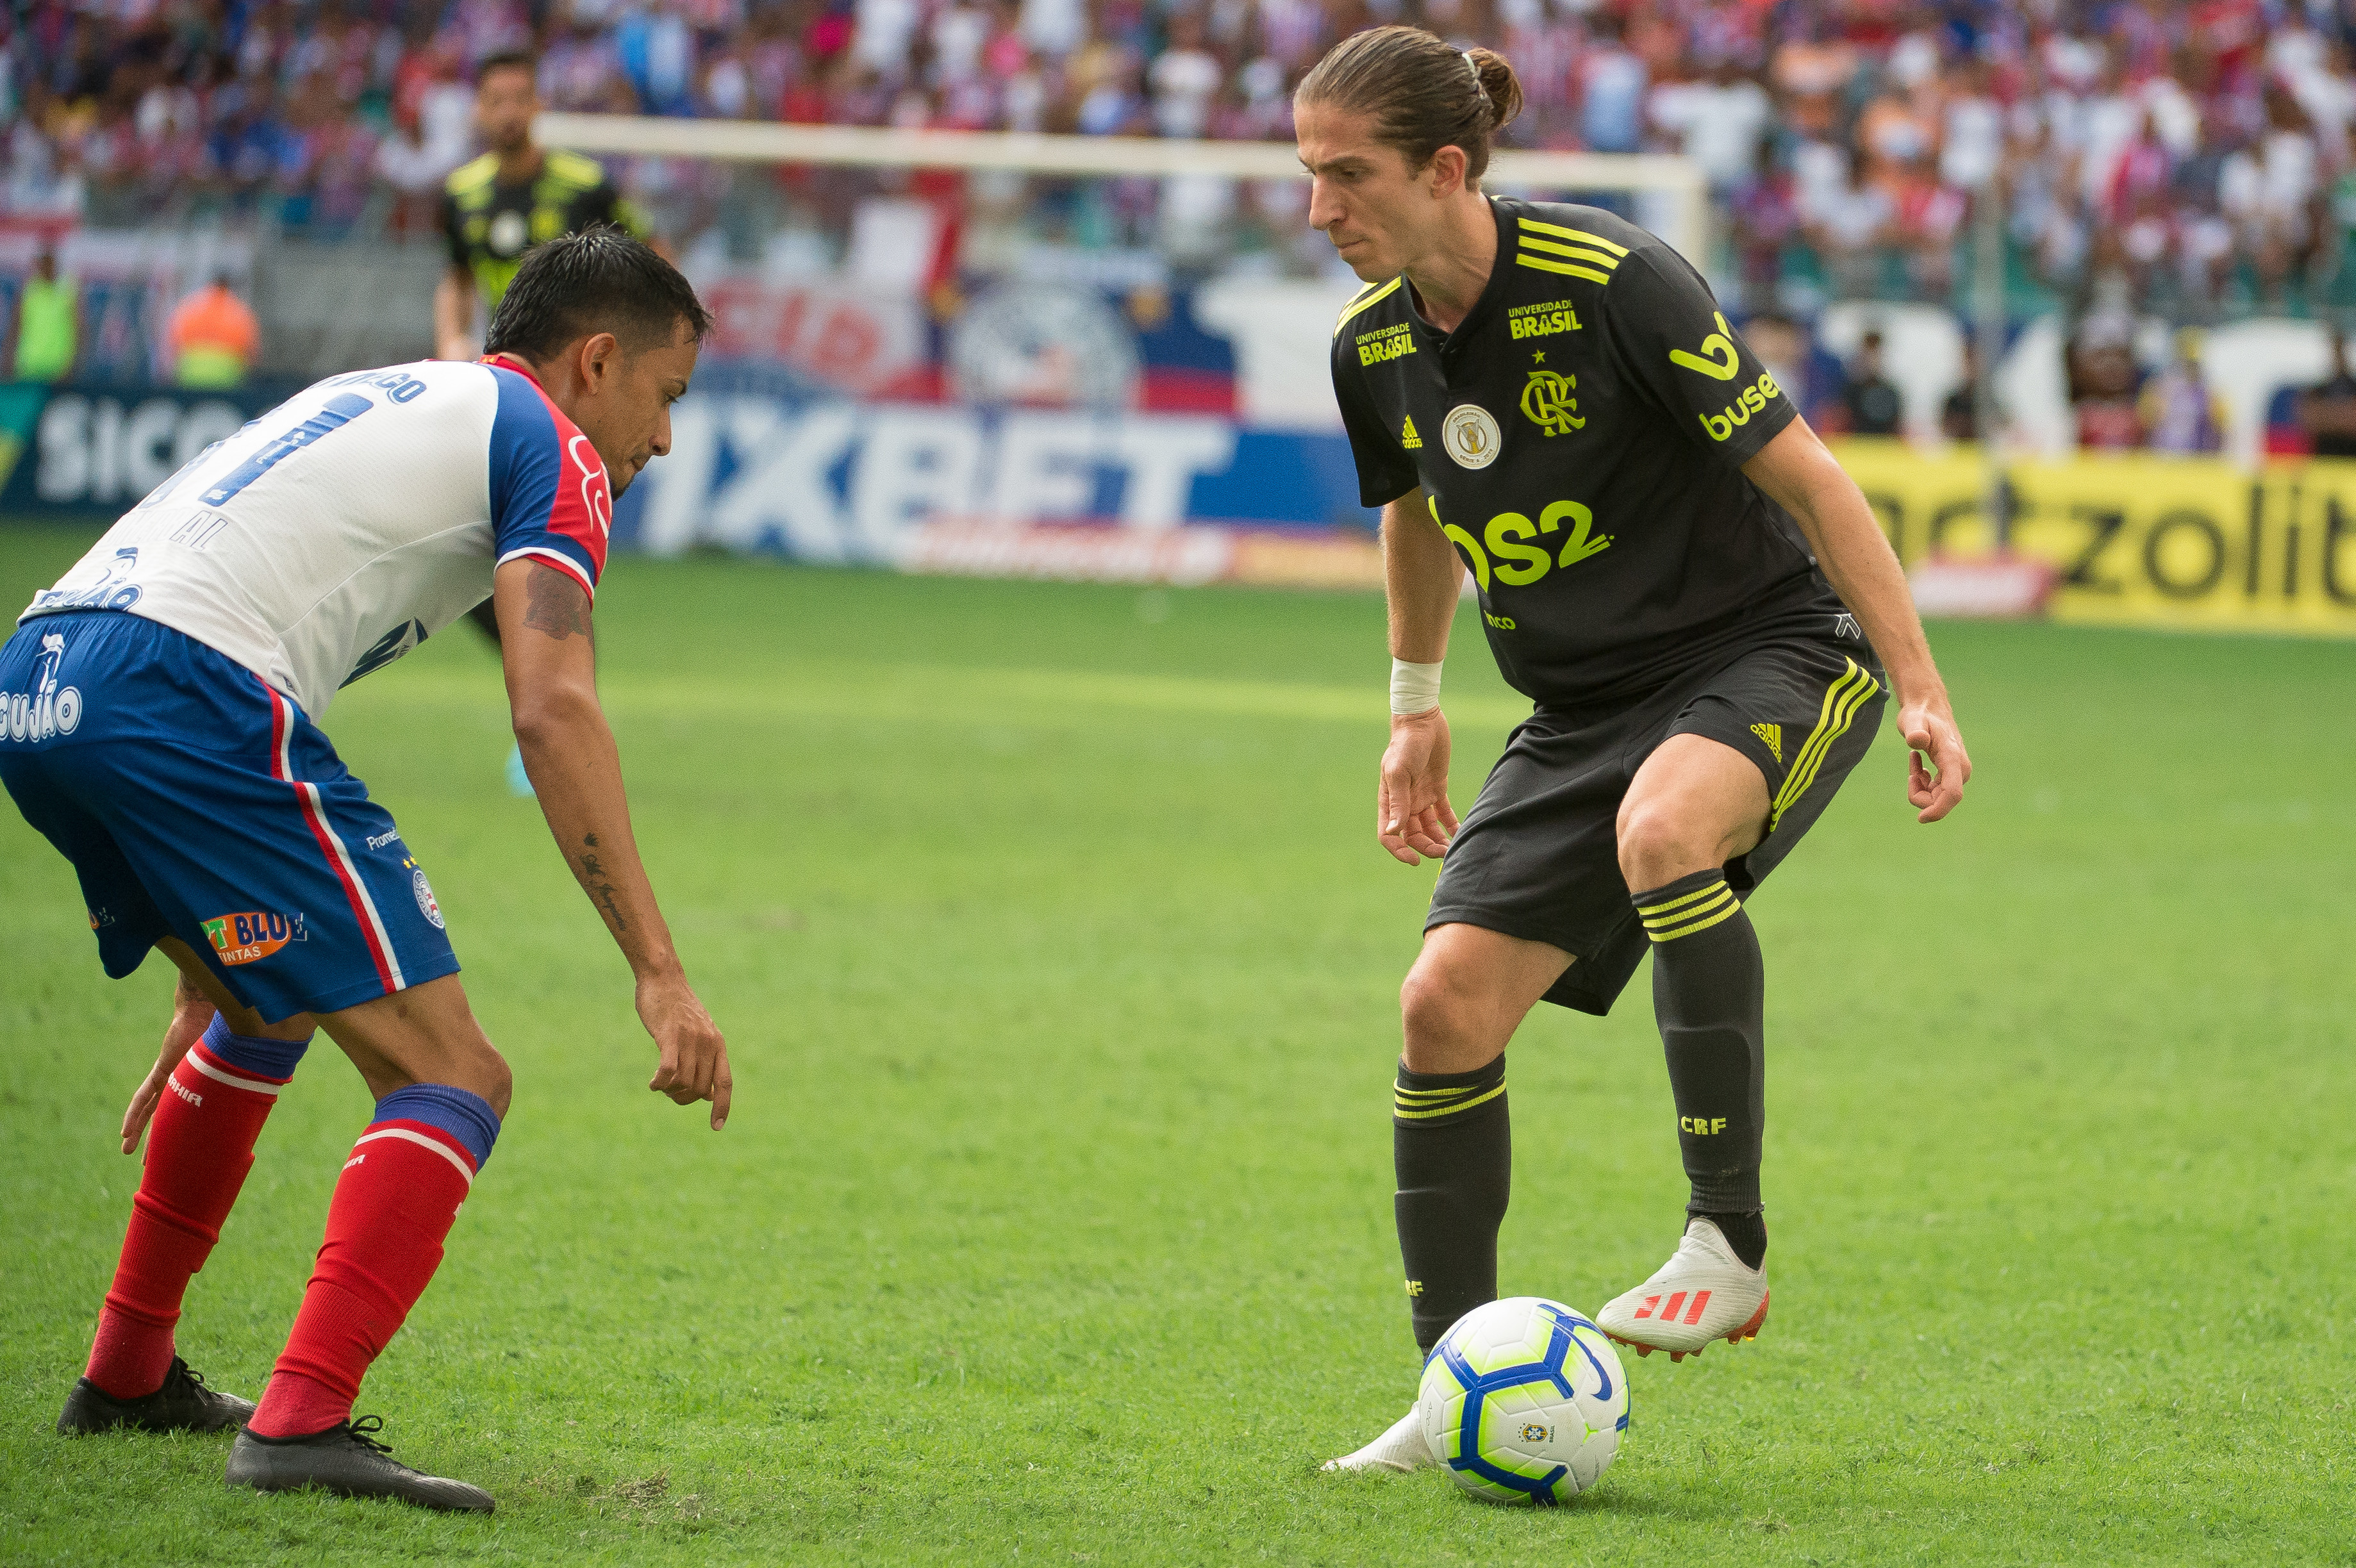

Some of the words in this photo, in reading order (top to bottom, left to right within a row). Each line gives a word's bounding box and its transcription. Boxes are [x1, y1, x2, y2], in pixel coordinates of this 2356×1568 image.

[1507, 299, 1573, 318] UNIVERSIDADE
[1355, 322, 1411, 345] UNIVERSIDADE
[1509, 310, 1582, 340] BRASIL
[1357, 333, 1417, 367] BRASIL
[1750, 723, 1782, 763] adidas
[233, 911, 308, 947] BLUE
[1680, 1116, 1727, 1135] CRF
